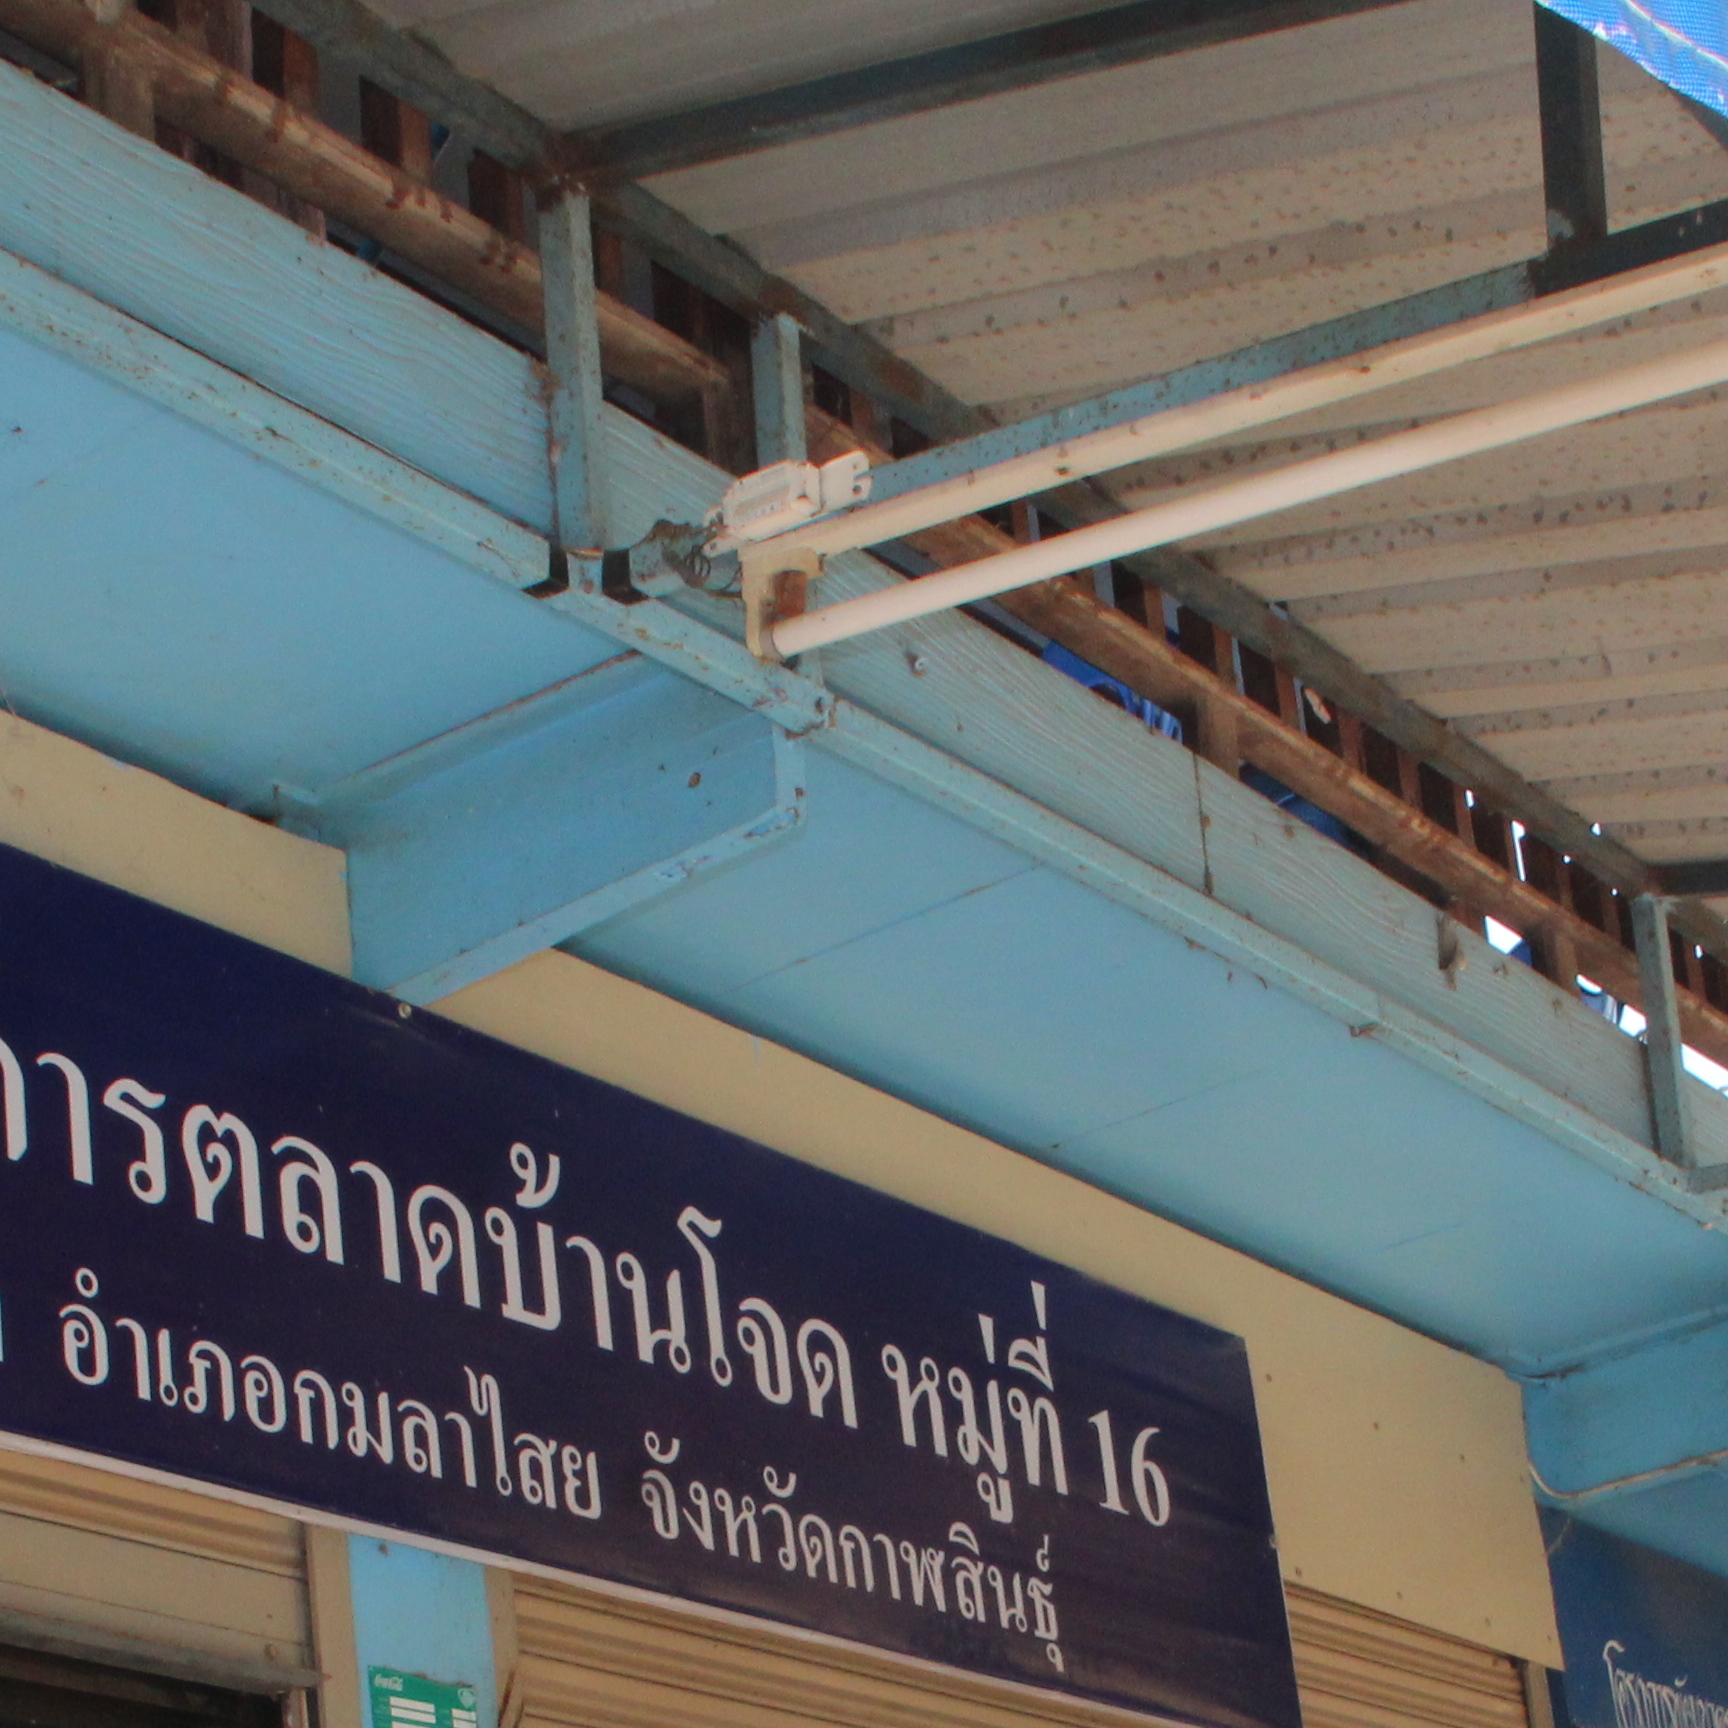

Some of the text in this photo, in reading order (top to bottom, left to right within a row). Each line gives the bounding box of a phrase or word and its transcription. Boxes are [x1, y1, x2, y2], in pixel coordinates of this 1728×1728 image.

[59, 1266, 604, 1521] อำเภอกมลาไสย
[638, 1430, 1067, 1673] จังหวัดกาฬสินธุ์
[882, 1282, 1069, 1525] หมู่ที่
[1086, 1408, 1173, 1528] 16
